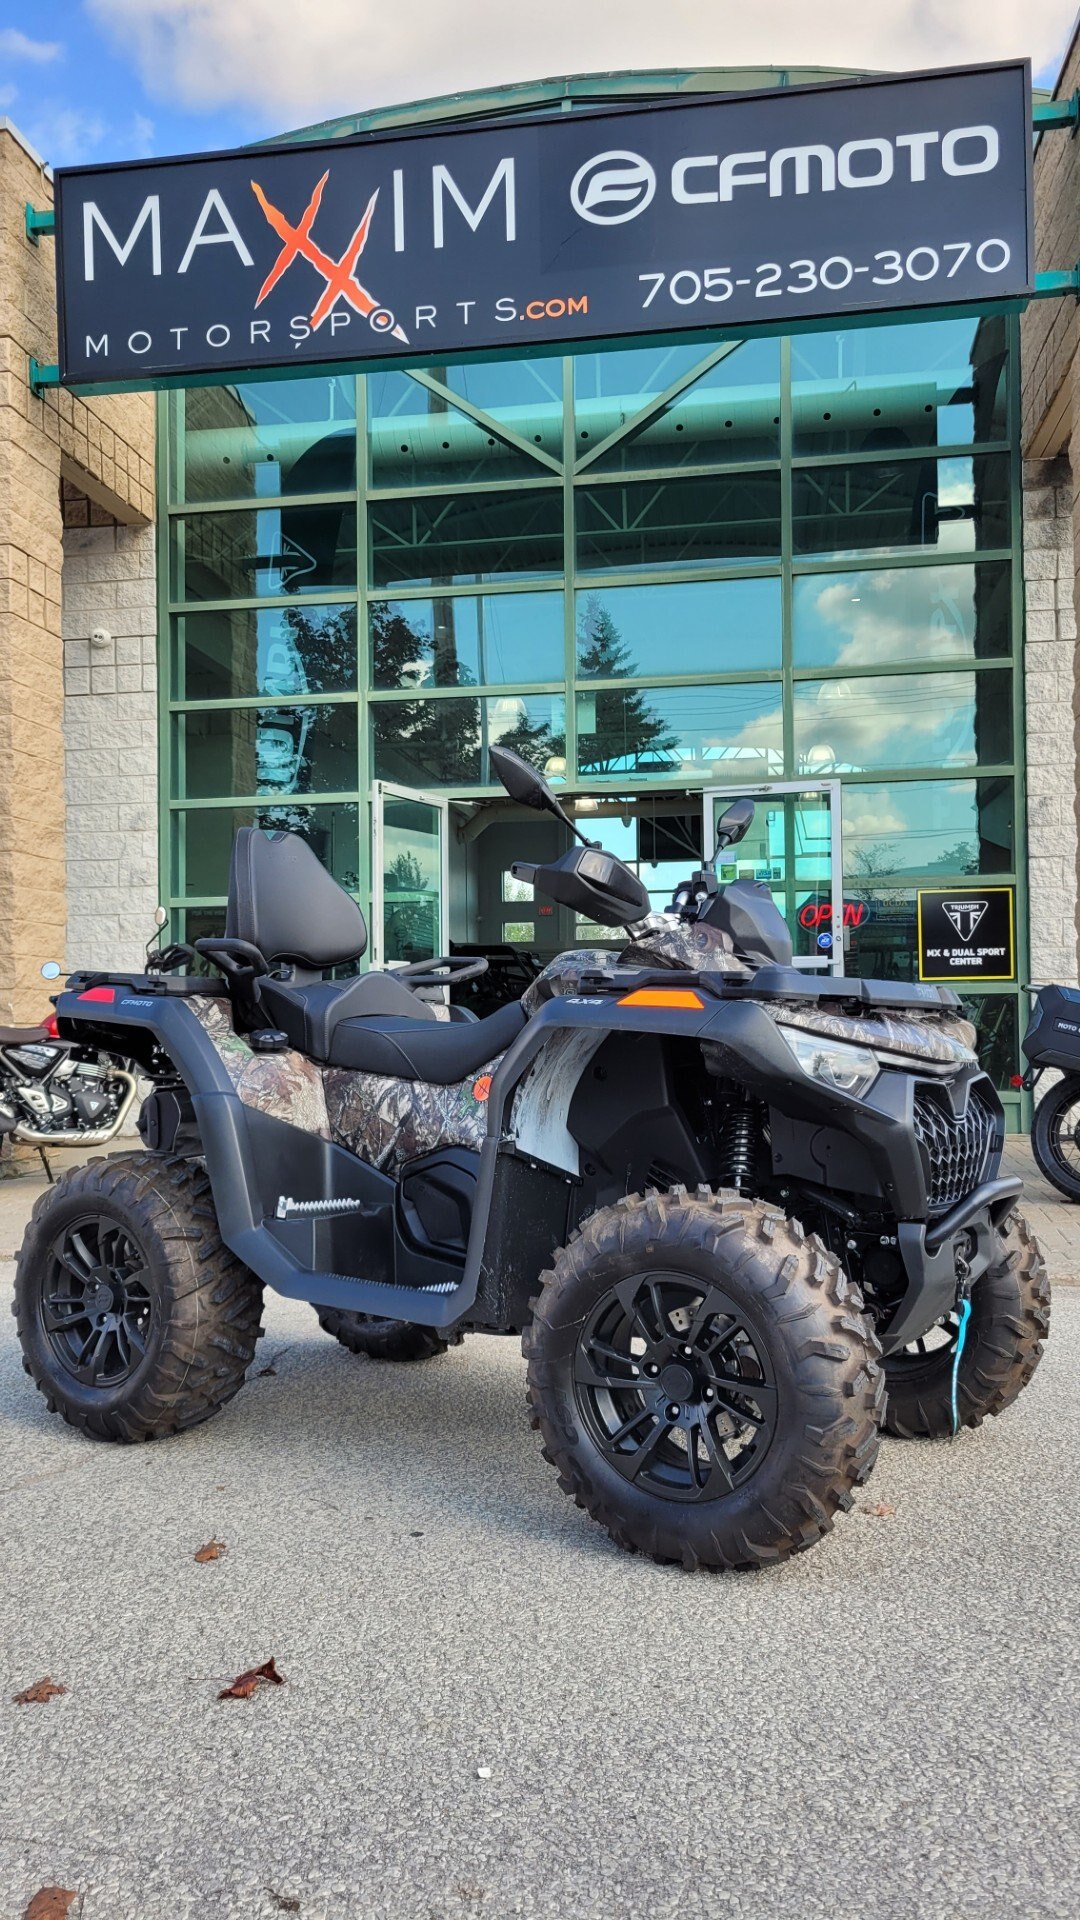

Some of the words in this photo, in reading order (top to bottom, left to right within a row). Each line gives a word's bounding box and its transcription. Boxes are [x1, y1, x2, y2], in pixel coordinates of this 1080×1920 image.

[671, 125, 999, 205] CFMOTO
[82, 157, 516, 332] MAXIM
[638, 238, 1011, 308] 705-230-3070
[800, 903, 865, 927] OPN
[926, 949, 941, 957] MX
[943, 949, 950, 957] &
[952, 948, 976, 956] DUAL
[977, 947, 1006, 956] SPORT
[949, 957, 983, 966] CENTER
[121, 999, 154, 1007] CFMOTO
[1057, 1022, 1077, 1032] MOTO
